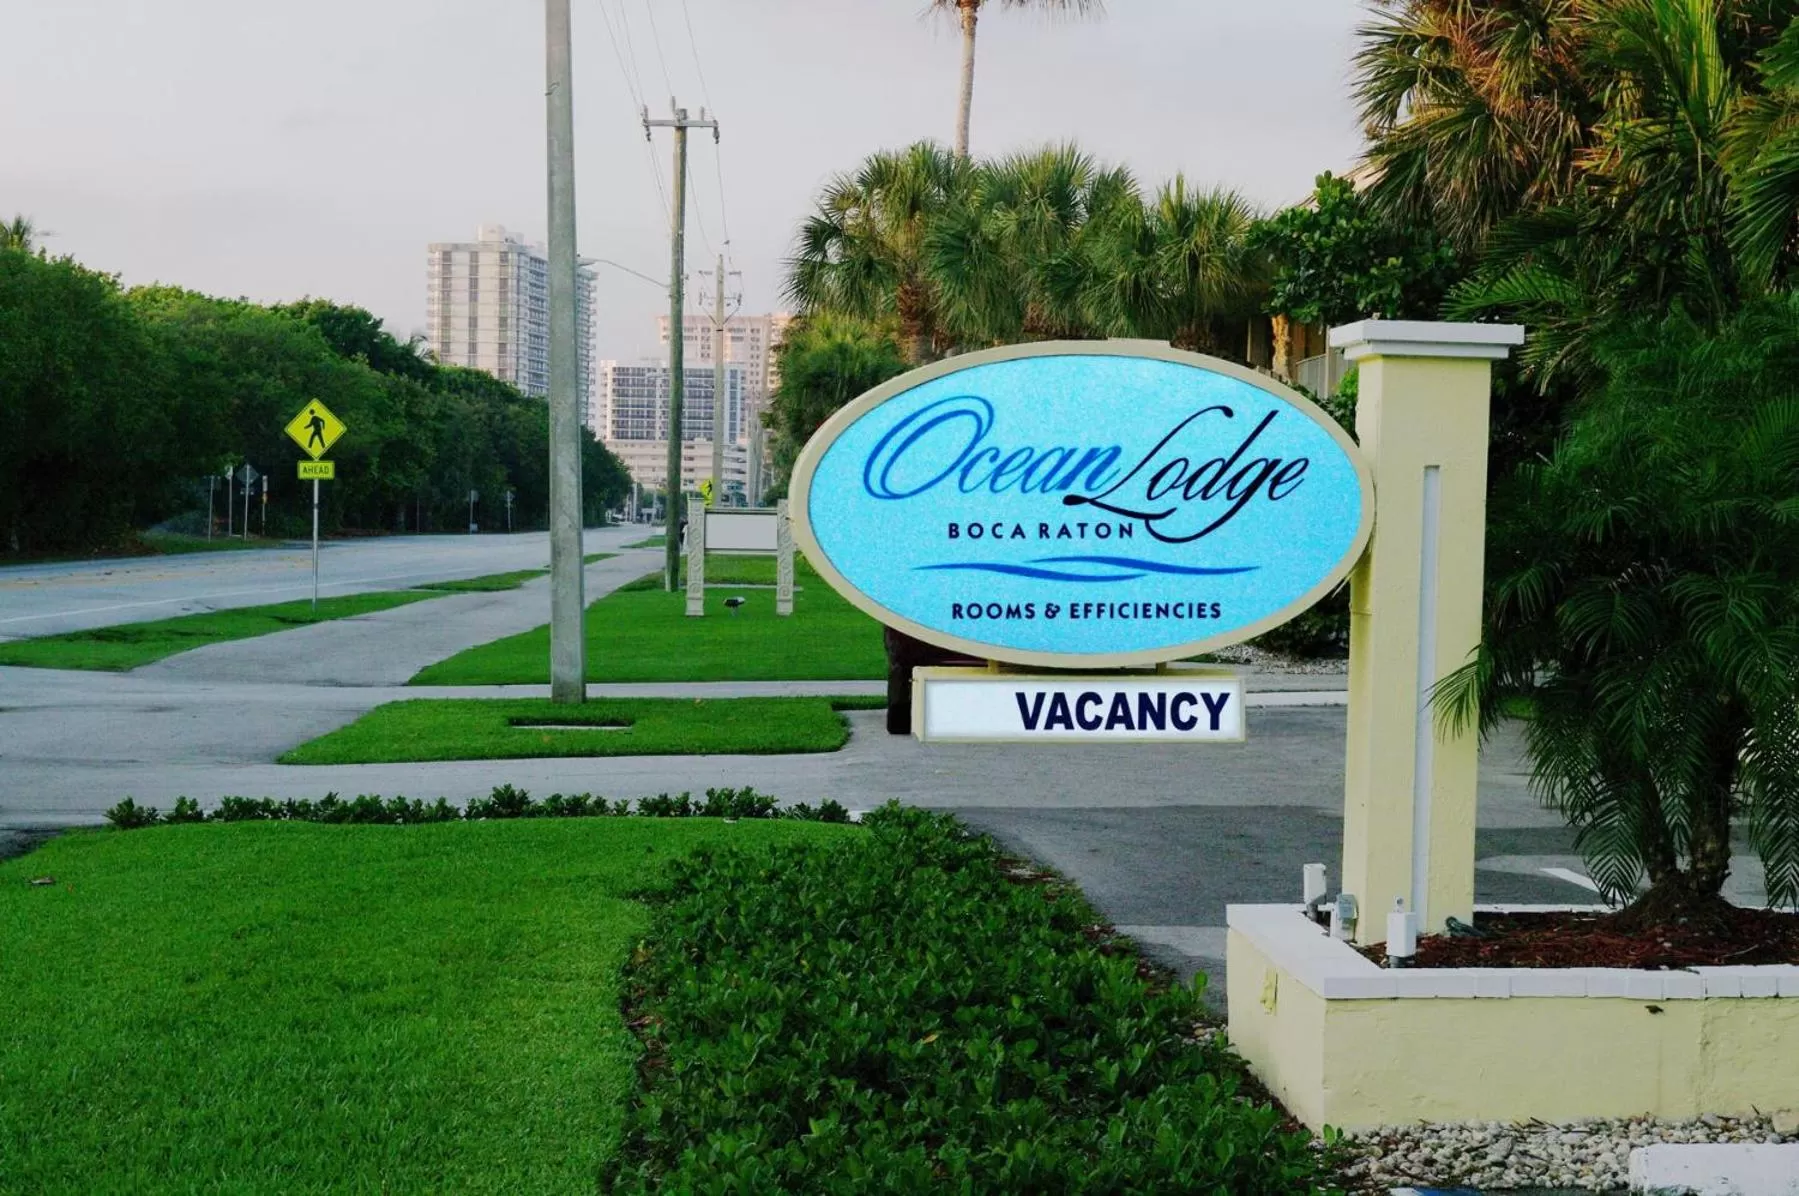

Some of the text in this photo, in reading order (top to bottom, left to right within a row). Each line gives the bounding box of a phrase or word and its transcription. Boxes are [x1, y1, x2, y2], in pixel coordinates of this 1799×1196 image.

[302, 466, 329, 475] AHEAD
[863, 395, 1310, 544] Ocean Lodge
[948, 522, 1134, 539] BOCA RATON
[952, 602, 1222, 620] ROOMS & EFFICIENCIES
[1015, 690, 1231, 732] VACANCY
